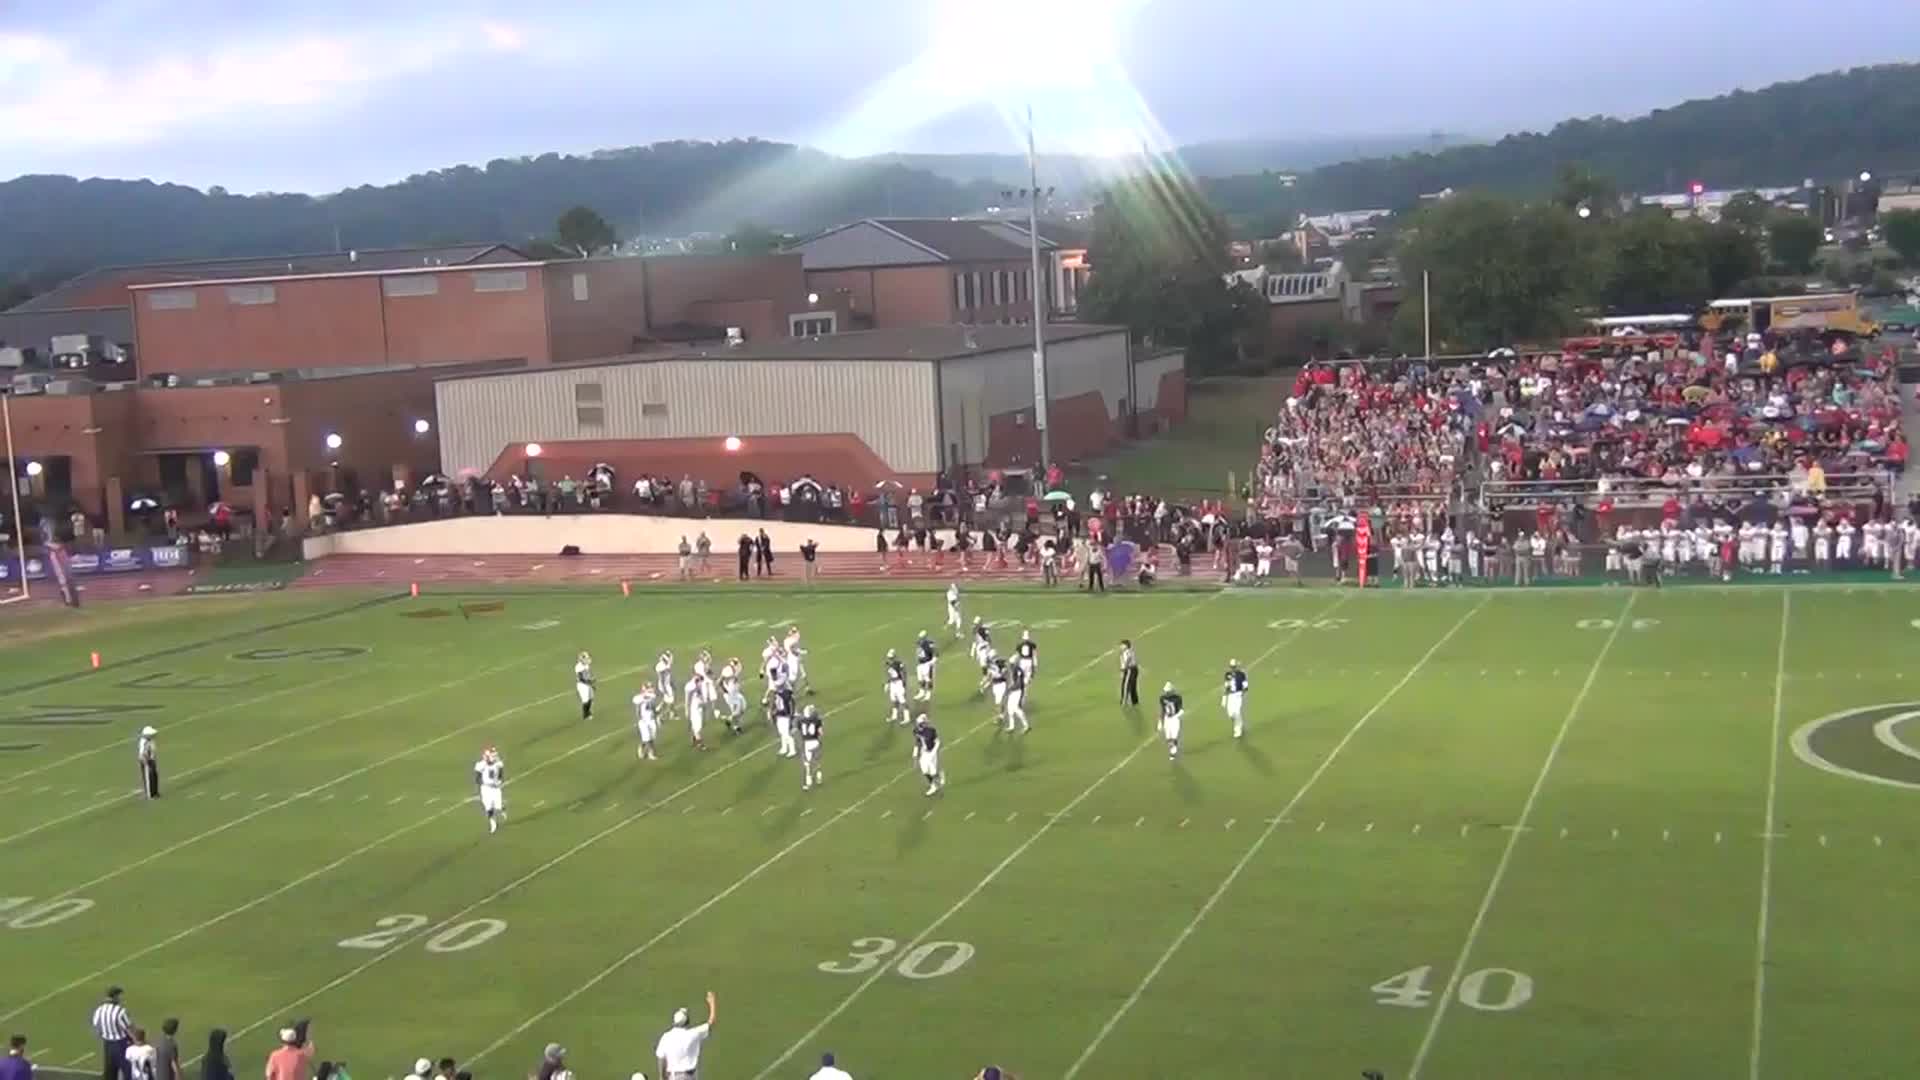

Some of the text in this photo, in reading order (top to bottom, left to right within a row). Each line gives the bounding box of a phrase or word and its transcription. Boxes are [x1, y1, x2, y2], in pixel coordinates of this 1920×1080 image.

[337, 913, 508, 953] 20
[817, 936, 975, 980] 30
[1369, 965, 1535, 1011] 40
